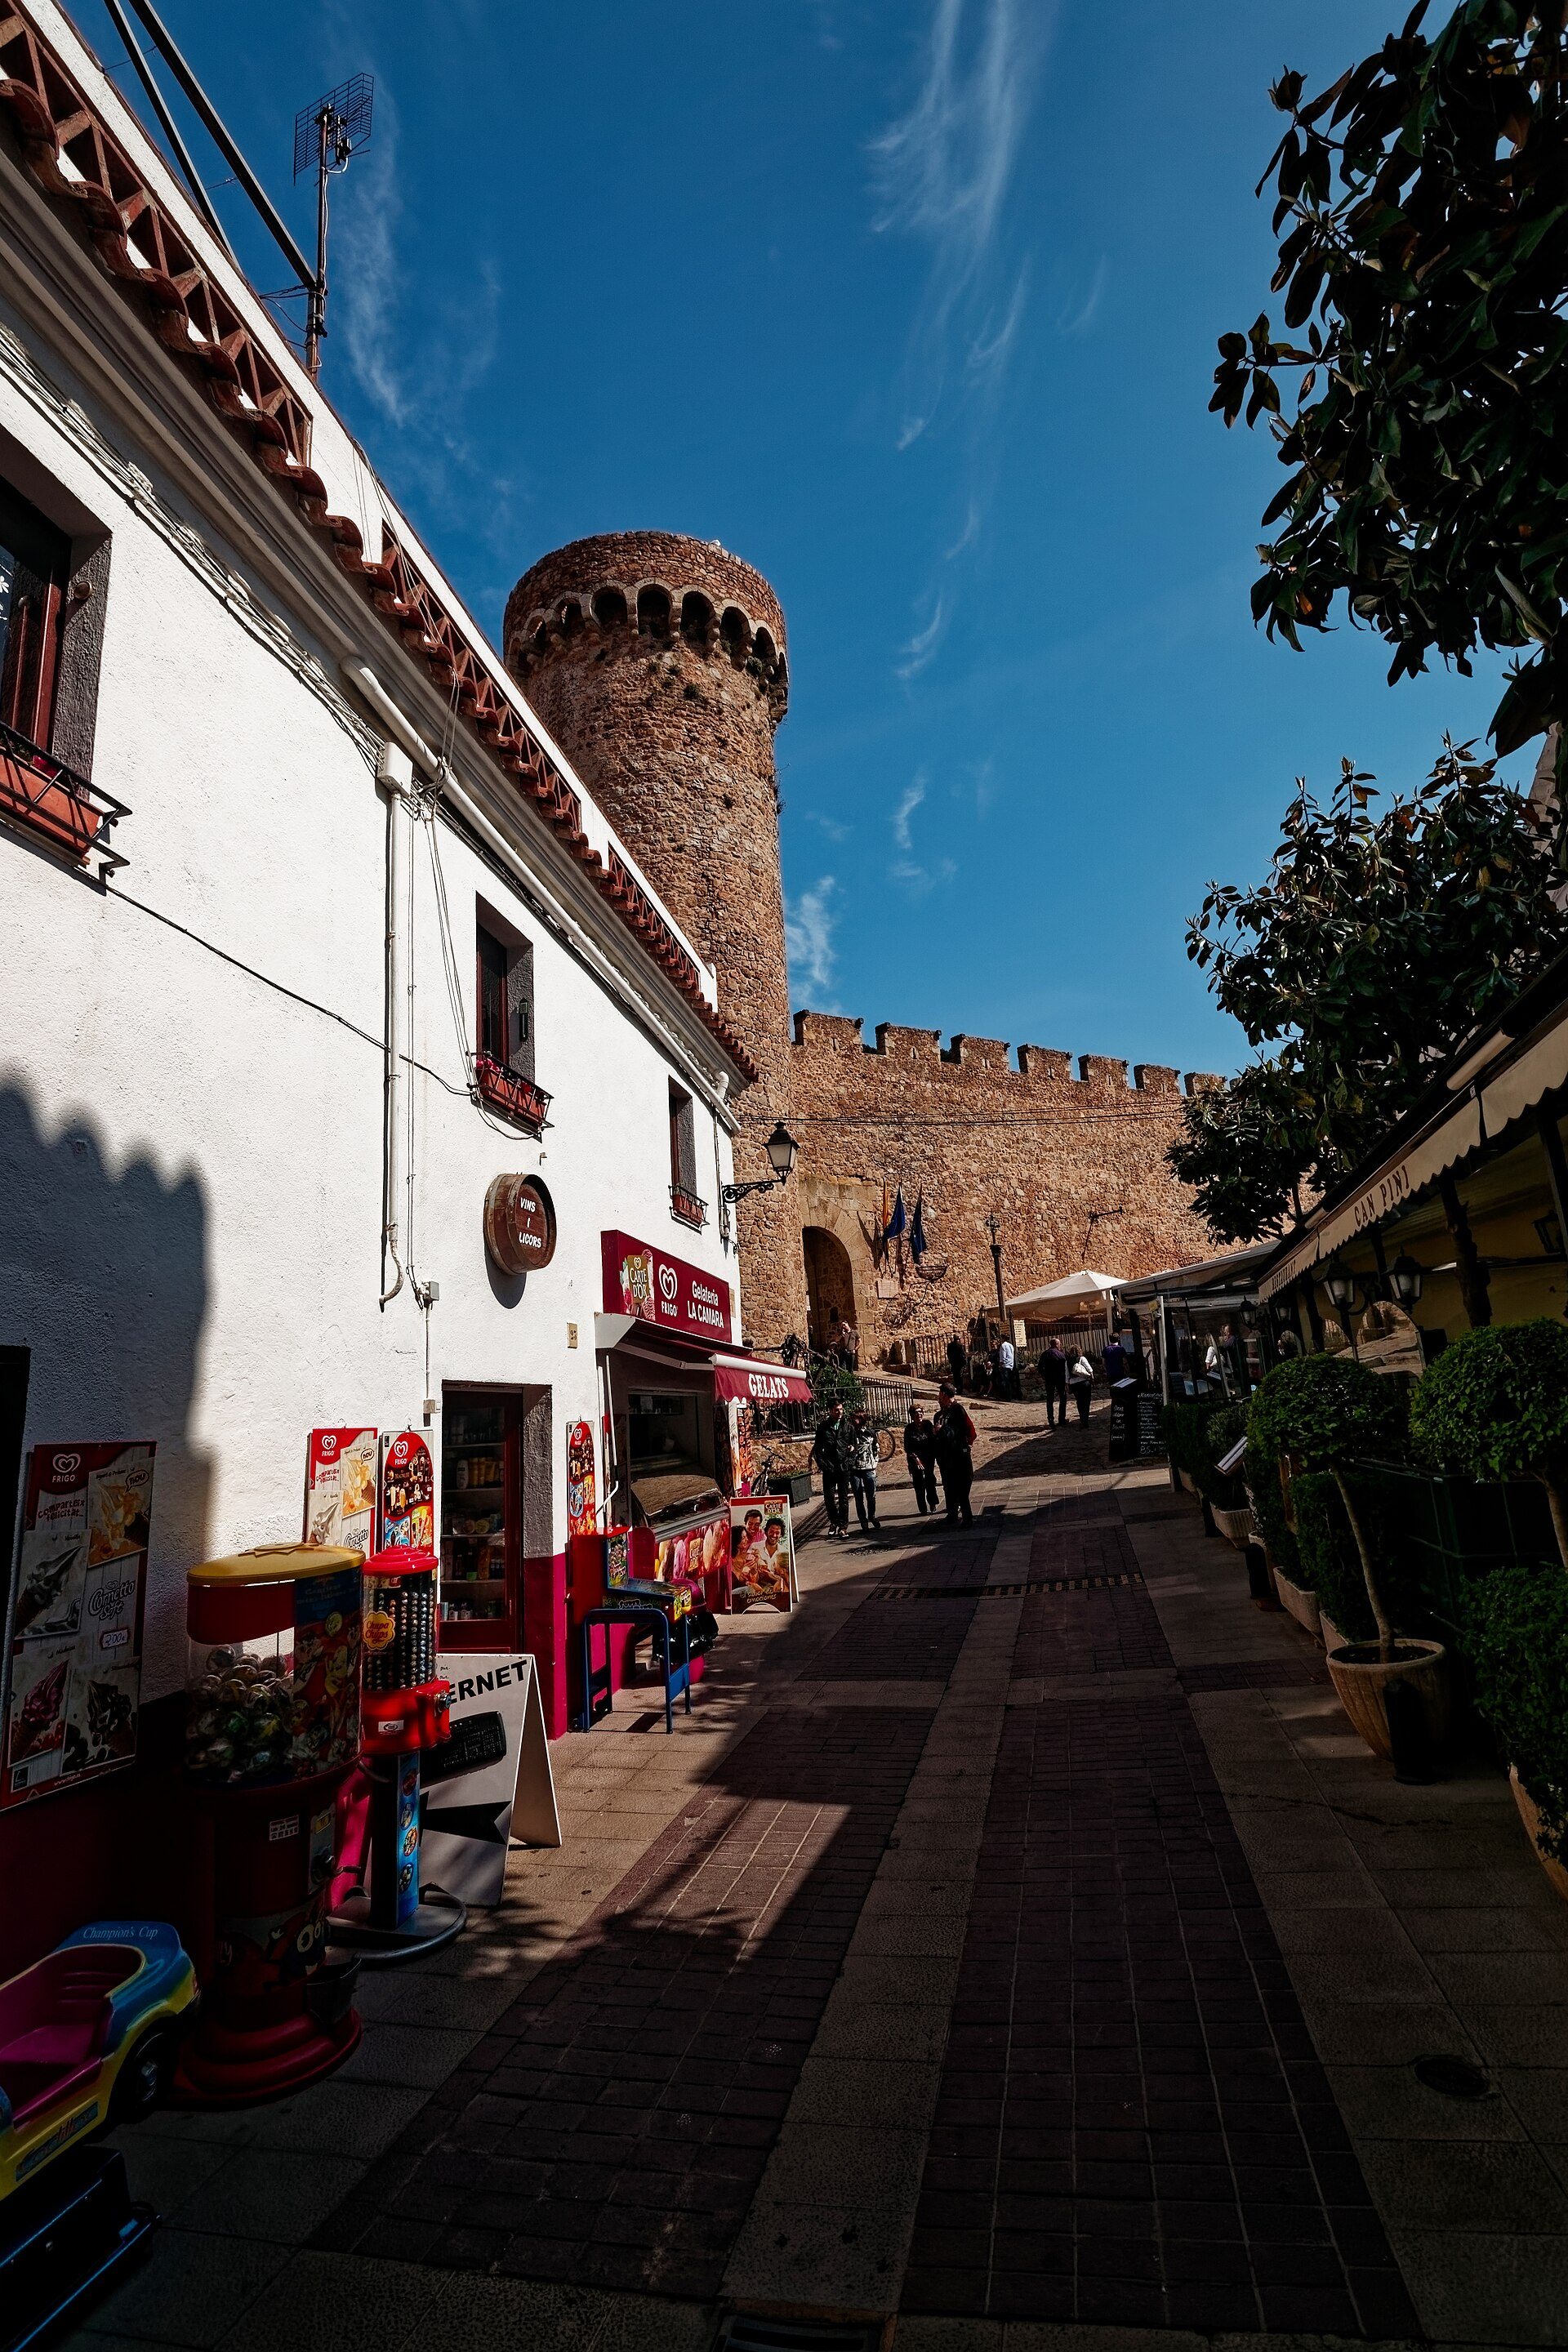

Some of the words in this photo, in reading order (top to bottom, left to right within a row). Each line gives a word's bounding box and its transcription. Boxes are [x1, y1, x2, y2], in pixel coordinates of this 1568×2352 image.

[1355, 1193, 1375, 1227] CAN
[1379, 1165, 1409, 1207] PINI
[520, 1197, 537, 1213] VINS
[519, 1232, 542, 1249] LICORS
[629, 1267, 648, 1283] CARTE
[633, 1283, 648, 1299] D'OR
[692, 1280, 719, 1306] Gelateria
[661, 1301, 677, 1317] FRIGO
[687, 1300, 697, 1320] LA
[697, 1305, 724, 1329] CAMARA
[748, 1373, 790, 1399] GELATS
[51, 1474, 76, 1484] FRIGO
[88, 1580, 136, 1616] Cornetto
[366, 1620, 390, 1631] Chupa
[365, 1629, 389, 1640] Chups
[82, 1927, 135, 1940] Champion's
[138, 1927, 158, 1940] Cup
